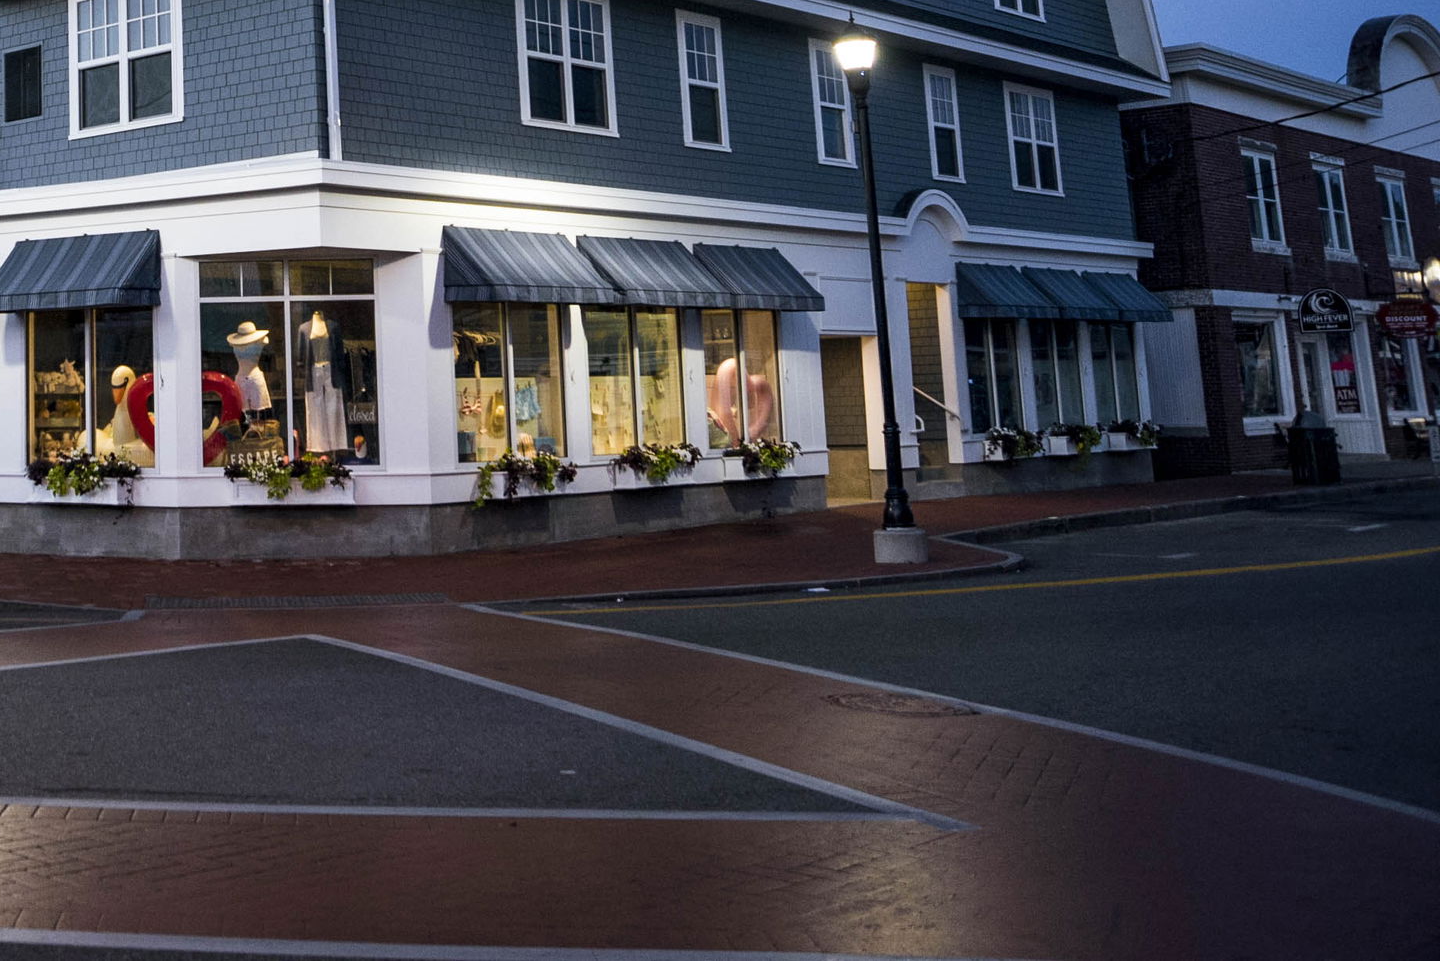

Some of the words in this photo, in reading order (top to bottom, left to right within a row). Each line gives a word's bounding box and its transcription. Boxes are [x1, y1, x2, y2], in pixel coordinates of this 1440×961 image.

[1303, 314, 1323, 323] HIGH
[1323, 313, 1348, 322] FEVER
[1337, 389, 1358, 400] ATM
[348, 404, 376, 422] closed
[230, 449, 278, 466] ESCAPE
